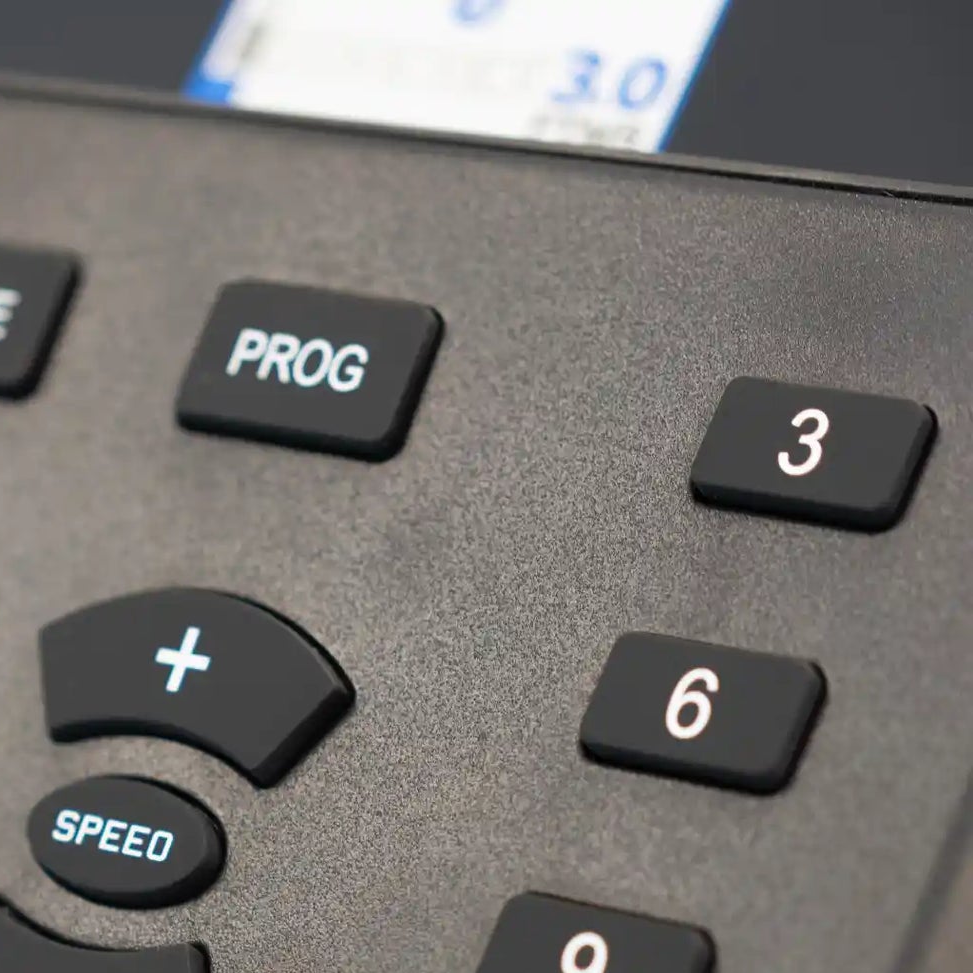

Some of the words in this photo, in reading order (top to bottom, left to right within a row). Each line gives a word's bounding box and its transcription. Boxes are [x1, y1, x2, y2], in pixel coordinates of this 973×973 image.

[226, 328, 370, 393] PROG
[777, 408, 830, 476] 3
[664, 667, 719, 740] 6
